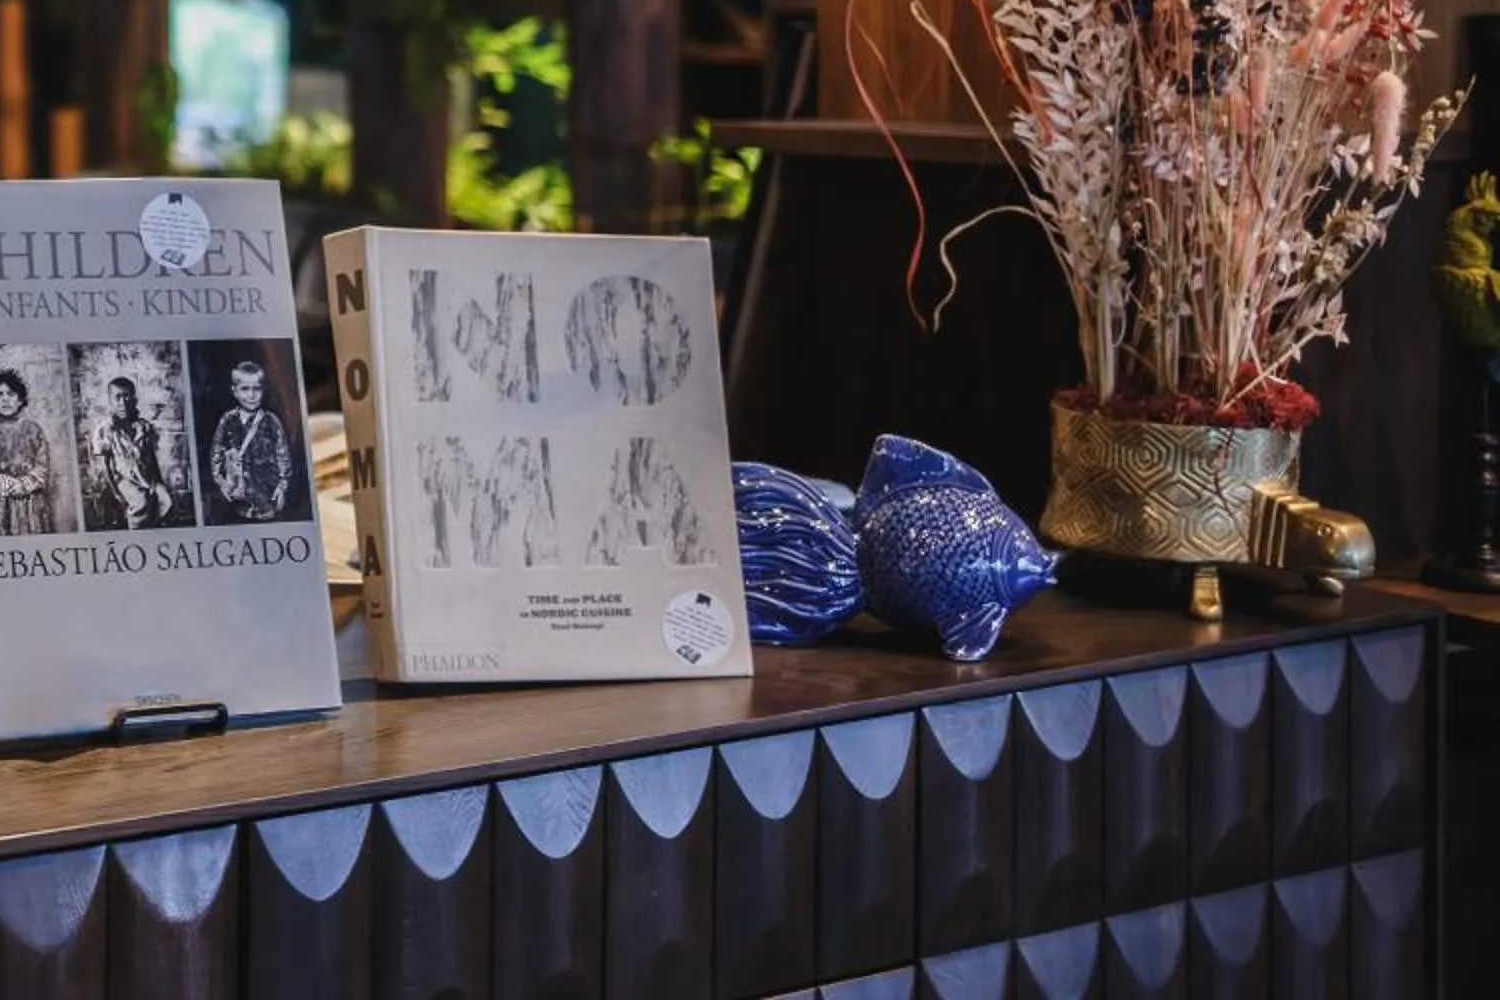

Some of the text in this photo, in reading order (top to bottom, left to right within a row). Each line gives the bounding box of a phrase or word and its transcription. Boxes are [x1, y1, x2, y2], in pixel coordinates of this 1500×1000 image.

[142, 286, 268, 316] KINDER
[335, 269, 382, 577] NOMA
[157, 535, 311, 570] SALGADO
[527, 594, 560, 604] TIME
[581, 593, 623, 604] PLACE
[531, 608, 579, 618] NORDIC
[580, 606, 633, 618] CUISINE
[411, 652, 500, 673] PHAIDON
